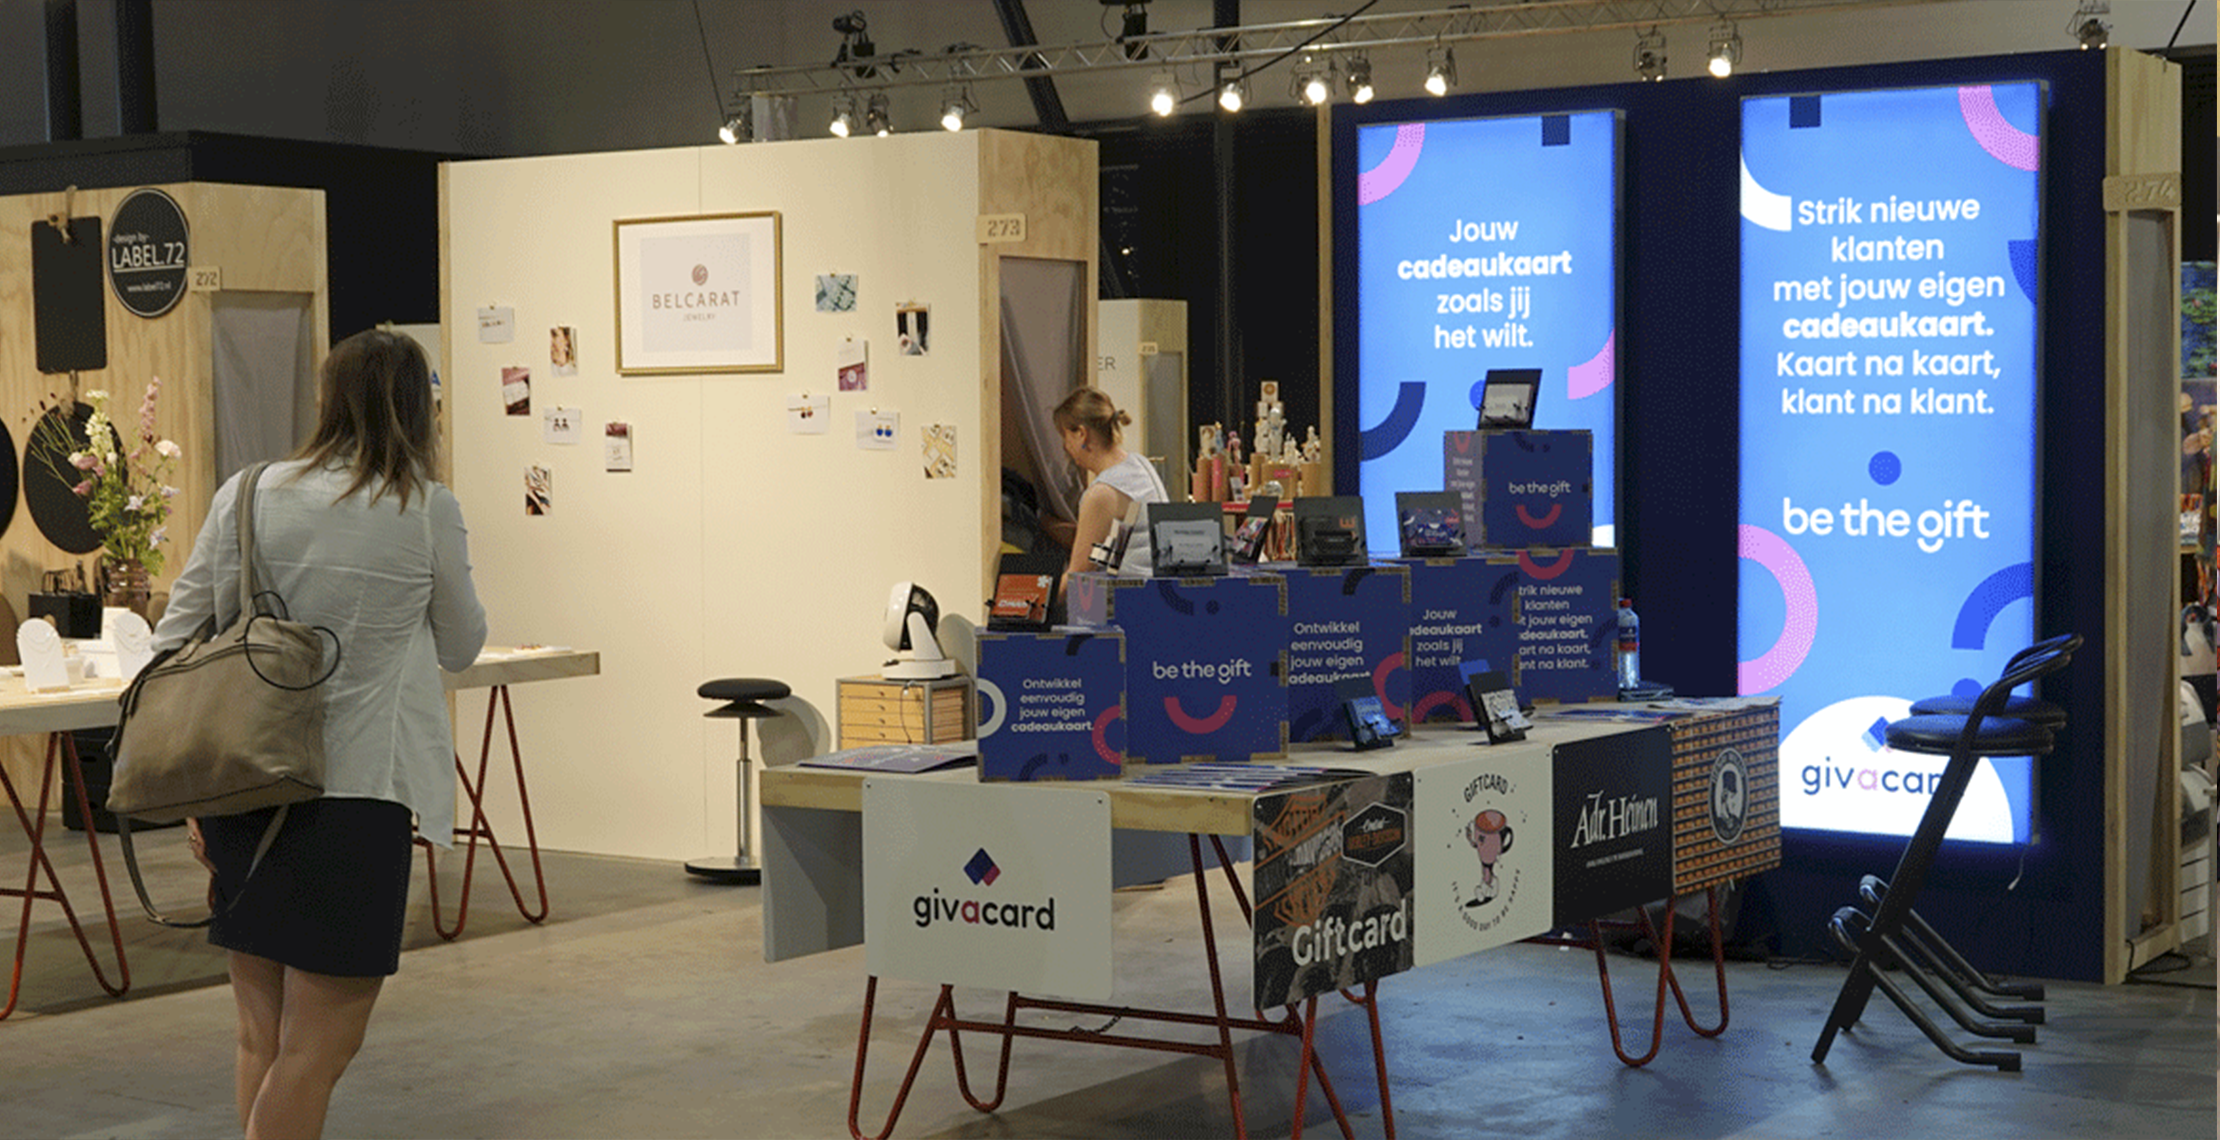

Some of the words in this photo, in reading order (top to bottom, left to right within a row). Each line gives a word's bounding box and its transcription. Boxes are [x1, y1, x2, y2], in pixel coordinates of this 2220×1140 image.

[1798, 197, 1862, 225] Strik
[1870, 195, 1980, 223] nieuwe
[987, 218, 1021, 237] 273
[1449, 219, 1518, 242] Jouw
[112, 242, 185, 269] LABEL.72
[1832, 235, 1944, 262] klanten
[1397, 250, 1572, 280] cadeaukaart
[195, 271, 218, 286] 272
[1773, 276, 1832, 301] met
[1837, 273, 1911, 308] jouw
[1918, 270, 2005, 306] eigen
[652, 290, 740, 310] BELCARAT
[1436, 287, 1502, 313] zoals
[1508, 286, 1531, 319] jij
[1783, 311, 1994, 339] cadeaukaart.
[1435, 324, 1476, 348] het
[1482, 322, 1533, 348] wilt.
[1777, 351, 1857, 376] Kaart
[1865, 354, 1903, 376] na
[1912, 349, 2000, 379] kaart,
[1782, 388, 1855, 414] klant
[1863, 393, 1901, 414] na
[1910, 388, 1994, 414] klant.
[1508, 482, 1526, 494] be
[1527, 481, 1549, 493] the
[1549, 480, 1571, 498] gift
[1783, 497, 1834, 535] be
[1840, 498, 1911, 536] the
[1917, 499, 1989, 553] gift
[1518, 584, 1538, 595] trik
[1540, 584, 1583, 595] nieuwe
[1423, 609, 1457, 620] Jouw
[1525, 600, 1570, 610] klanten
[1293, 621, 1359, 635] Ontwikkel
[1409, 623, 1482, 635] deaukaart
[1528, 614, 1557, 628] jouw
[1559, 613, 1593, 627] eigen
[1519, 629, 1588, 640] deaukaart.
[1291, 637, 1363, 653] eenvoudig
[1416, 640, 1450, 652] zoals
[1452, 638, 1463, 654] jij
[1519, 645, 1536, 655] art
[1290, 655, 1323, 671] jouw
[1325, 654, 1364, 670] eigen
[1415, 656, 1436, 667] het
[1153, 661, 1179, 679] be
[1181, 660, 1215, 679] the
[1218, 658, 1252, 685] gift
[1022, 678, 1082, 689] Ontwikkel
[1020, 692, 1085, 706] eenvoudig
[1019, 706, 1049, 721] jouw
[1051, 706, 1085, 720] eigen
[1011, 720, 1094, 733] cadeaukaart.
[1801, 756, 1944, 796] givacar
[1463, 773, 1509, 803] GIFTCARD
[1570, 789, 1606, 848] Adr.
[1608, 793, 1658, 838] Heinen
[913, 887, 1055, 931] givacard
[1292, 898, 1407, 967] Giftcard
